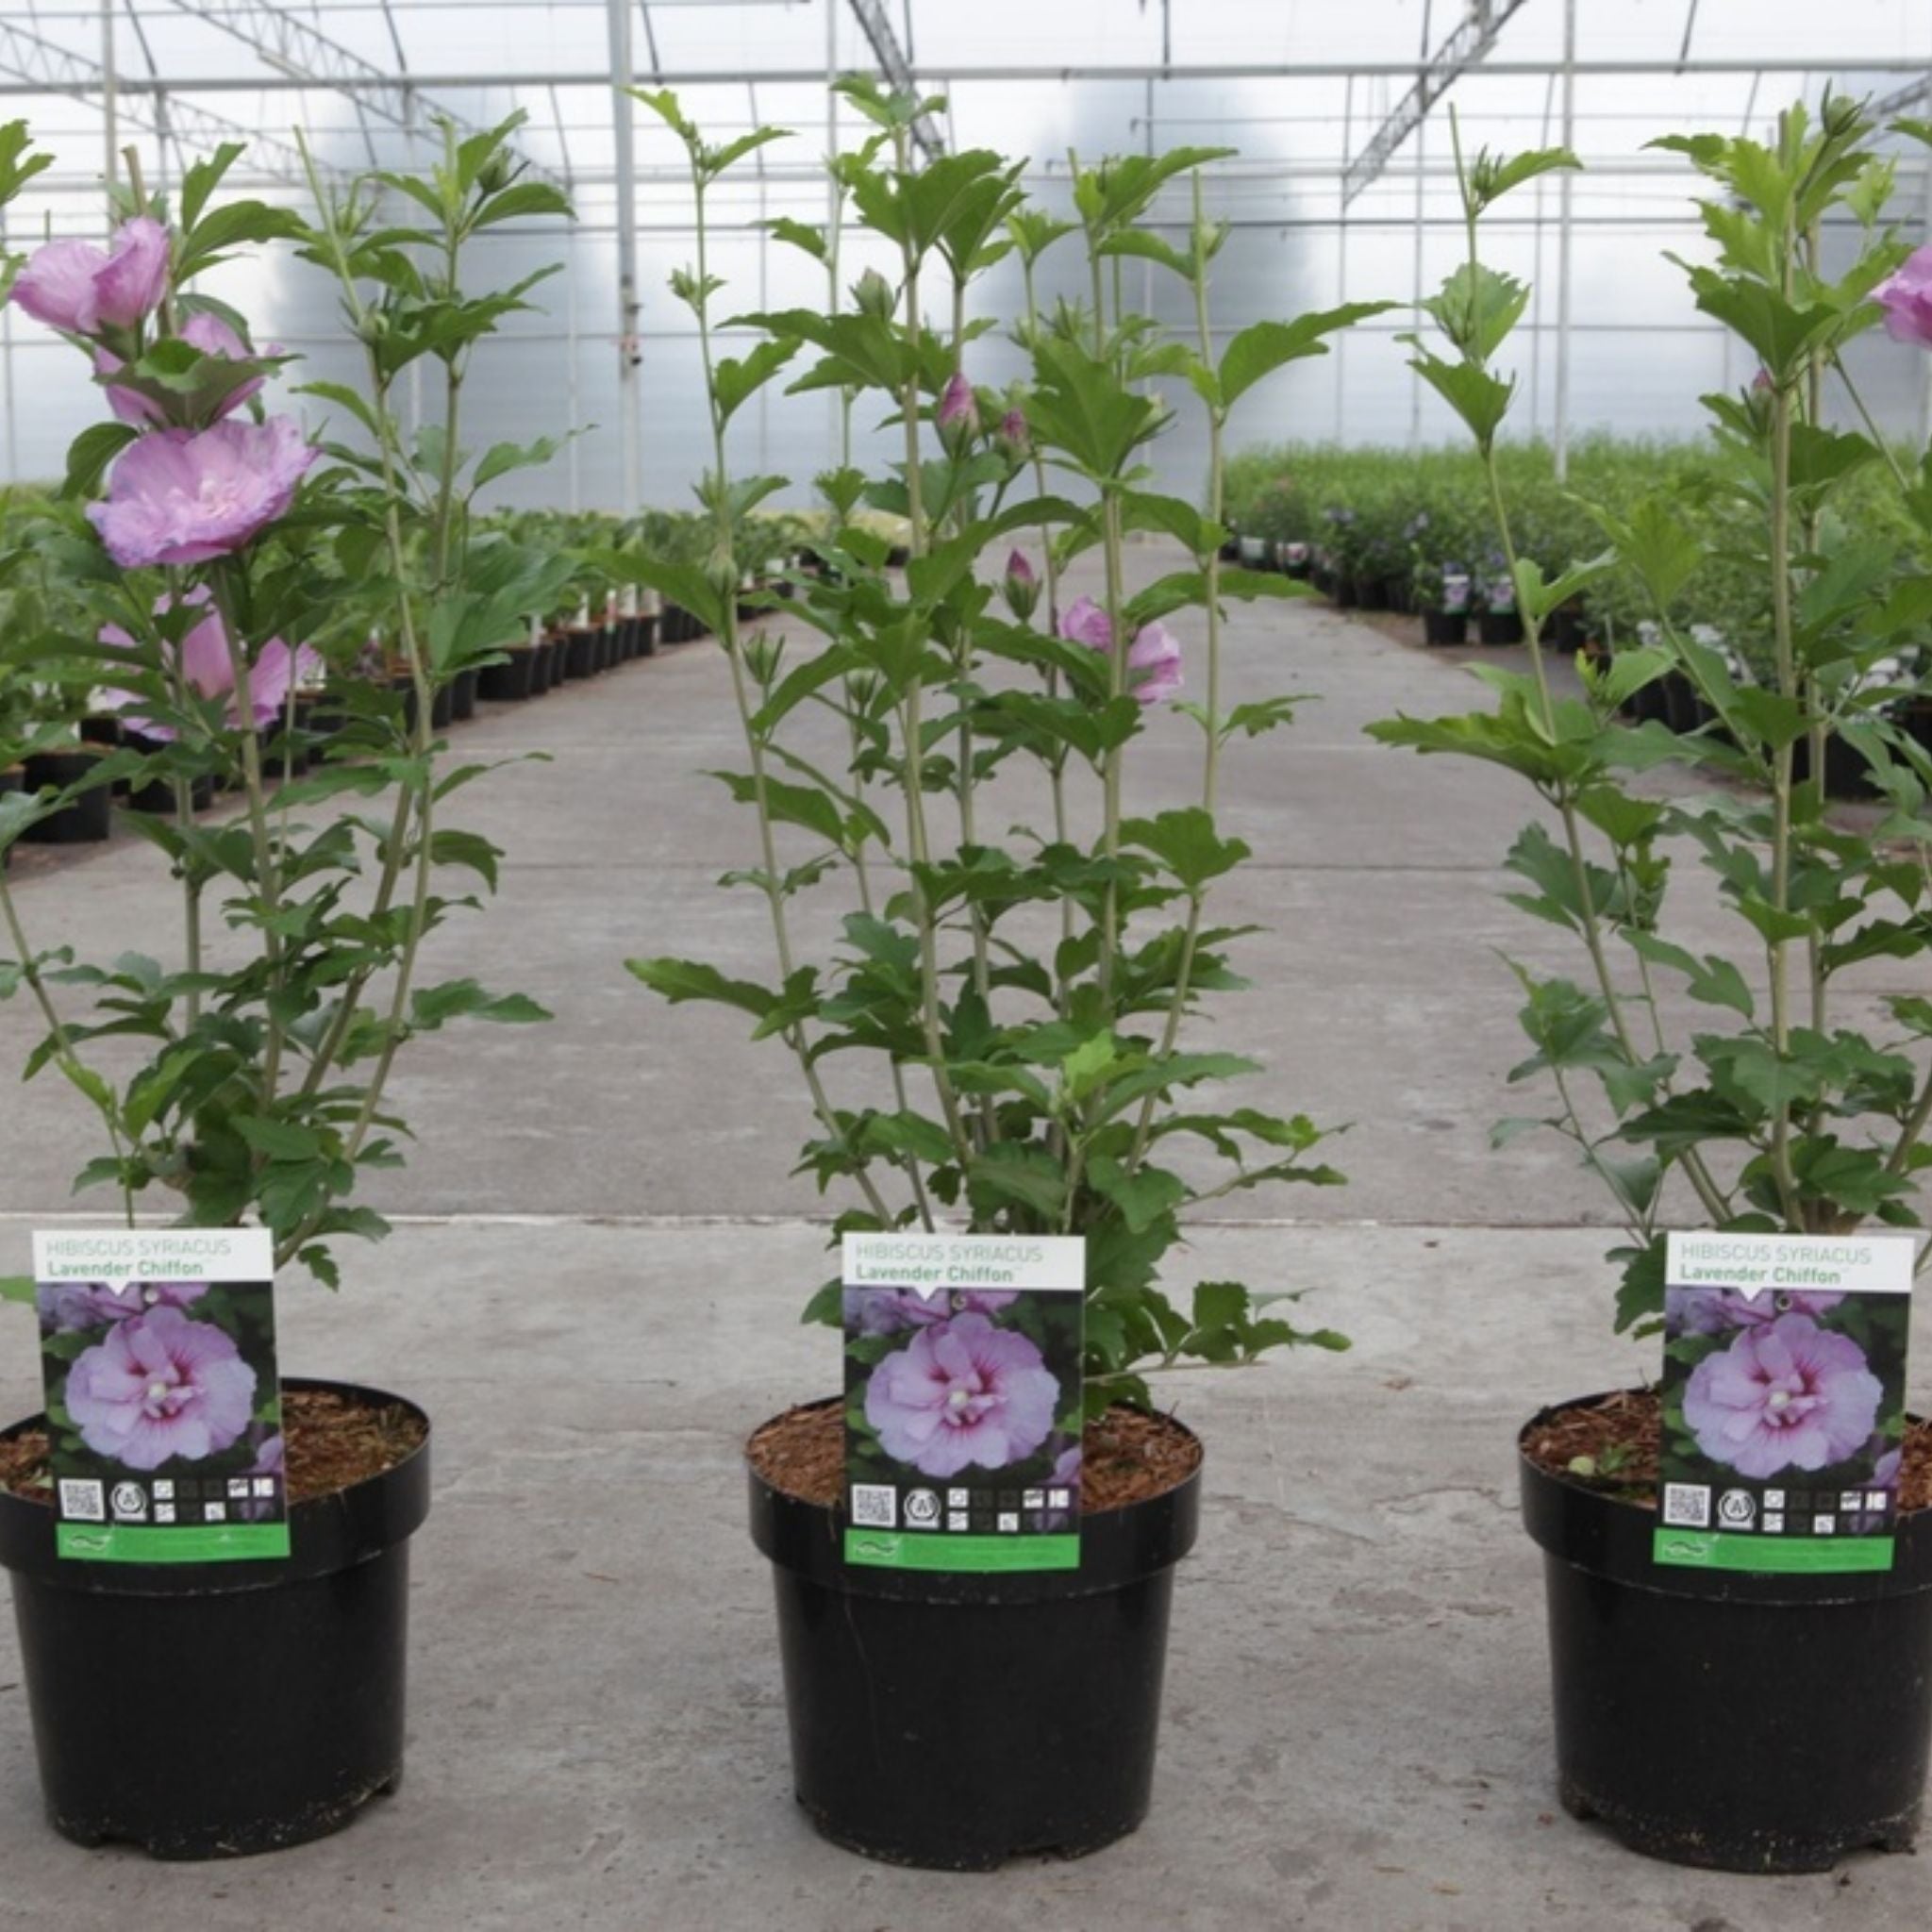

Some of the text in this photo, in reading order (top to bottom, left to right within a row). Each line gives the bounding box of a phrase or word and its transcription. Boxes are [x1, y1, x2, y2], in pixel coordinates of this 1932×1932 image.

[46, 1239, 232, 1256] HIBISCUS SYRIACUS
[856, 1243, 1043, 1262] HIBISCUS SYRIACUS
[1681, 1242, 1872, 1264] HIBISCUS SYRIACUS
[48, 1260, 204, 1277] Lavender Chiffon
[856, 1264, 1013, 1282] Lavender Chiffon
[1680, 1264, 1840, 1284] Lavender Chiffon
